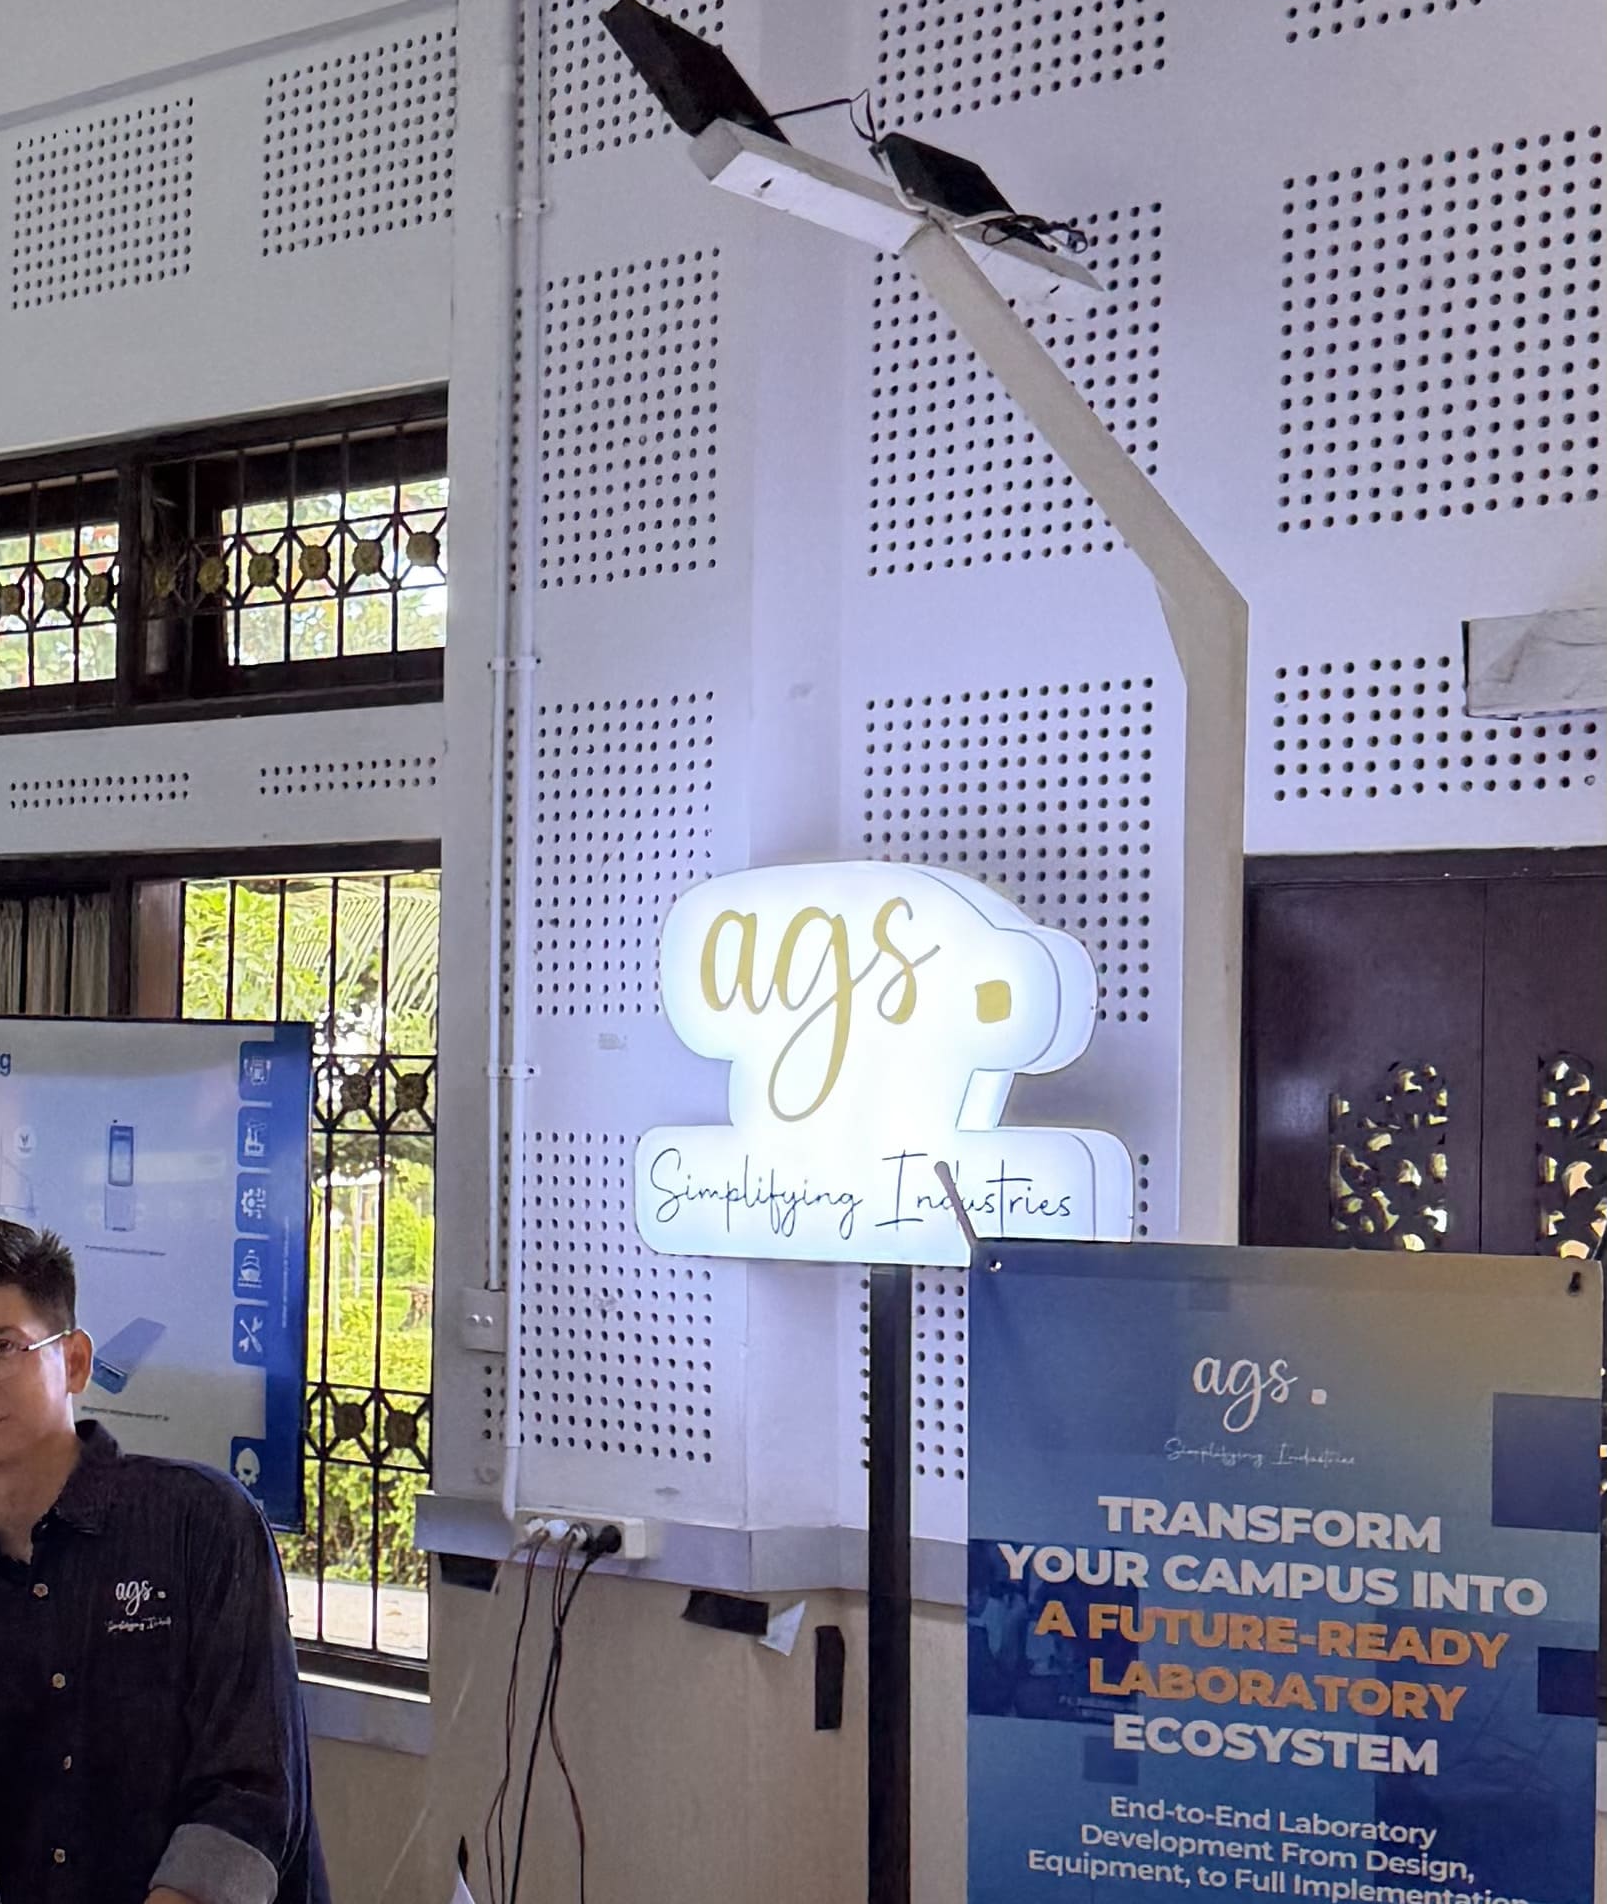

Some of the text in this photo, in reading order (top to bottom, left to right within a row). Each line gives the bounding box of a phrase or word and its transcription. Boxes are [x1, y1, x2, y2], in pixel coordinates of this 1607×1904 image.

[649, 1147, 864, 1240] Simplifying
[1097, 1495, 1442, 1554] TRANSFORM
[997, 1542, 1548, 1617] YOUR CAMPUS INTO
[1034, 1600, 1510, 1669] A FUTURE-READY
[1089, 1657, 1468, 1722] LABORATORY
[1113, 1712, 1439, 1776] ECOSYSTEM
[1080, 1823, 1475, 1884] Development From Design,
[1110, 1795, 1438, 1851] End-to-End Laboratory
[1027, 1848, 1191, 1888] Equipment,
[1197, 1865, 1227, 1888] to
[1234, 1867, 1286, 1894] Full
